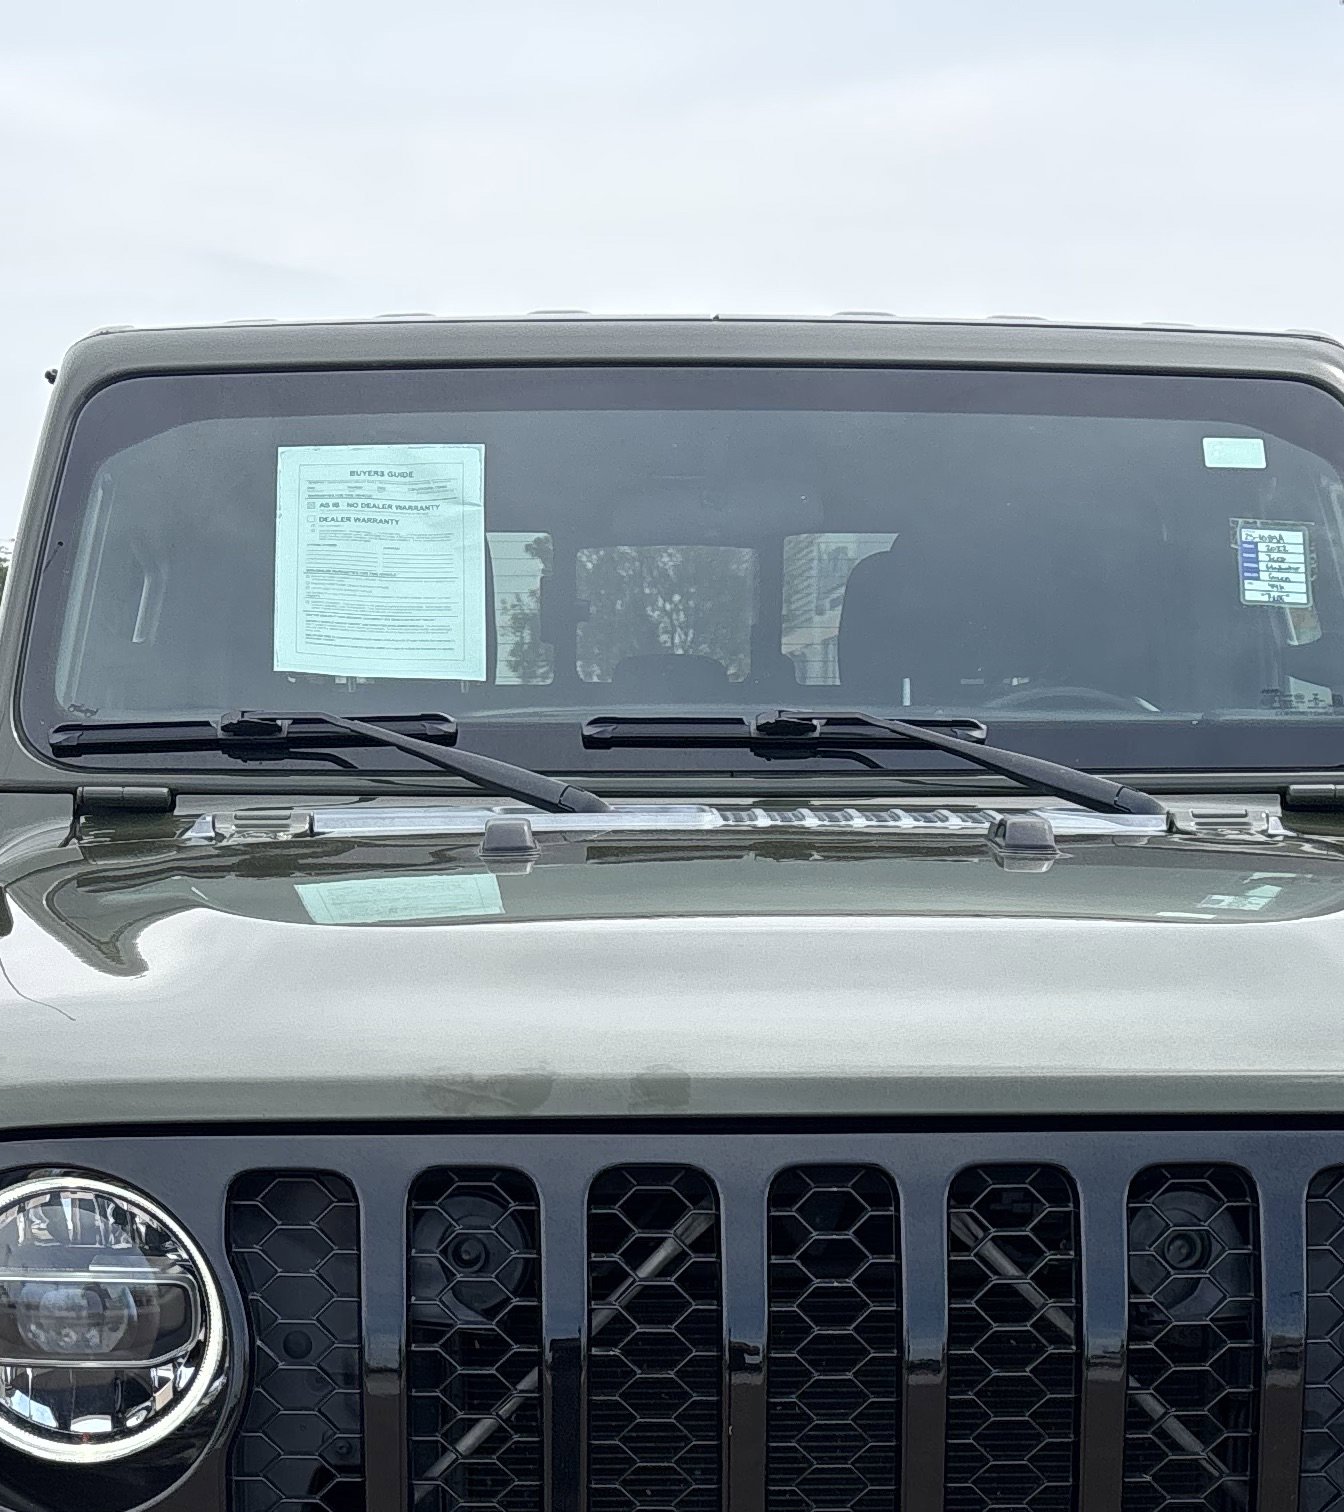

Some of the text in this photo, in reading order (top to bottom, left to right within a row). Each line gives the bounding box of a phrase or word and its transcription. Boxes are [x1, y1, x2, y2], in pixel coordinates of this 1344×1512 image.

[349, 470, 414, 478] BUYERS GUIDE
[395, 504, 440, 512] WARRANTY
[353, 516, 400, 526] WARRANTY
